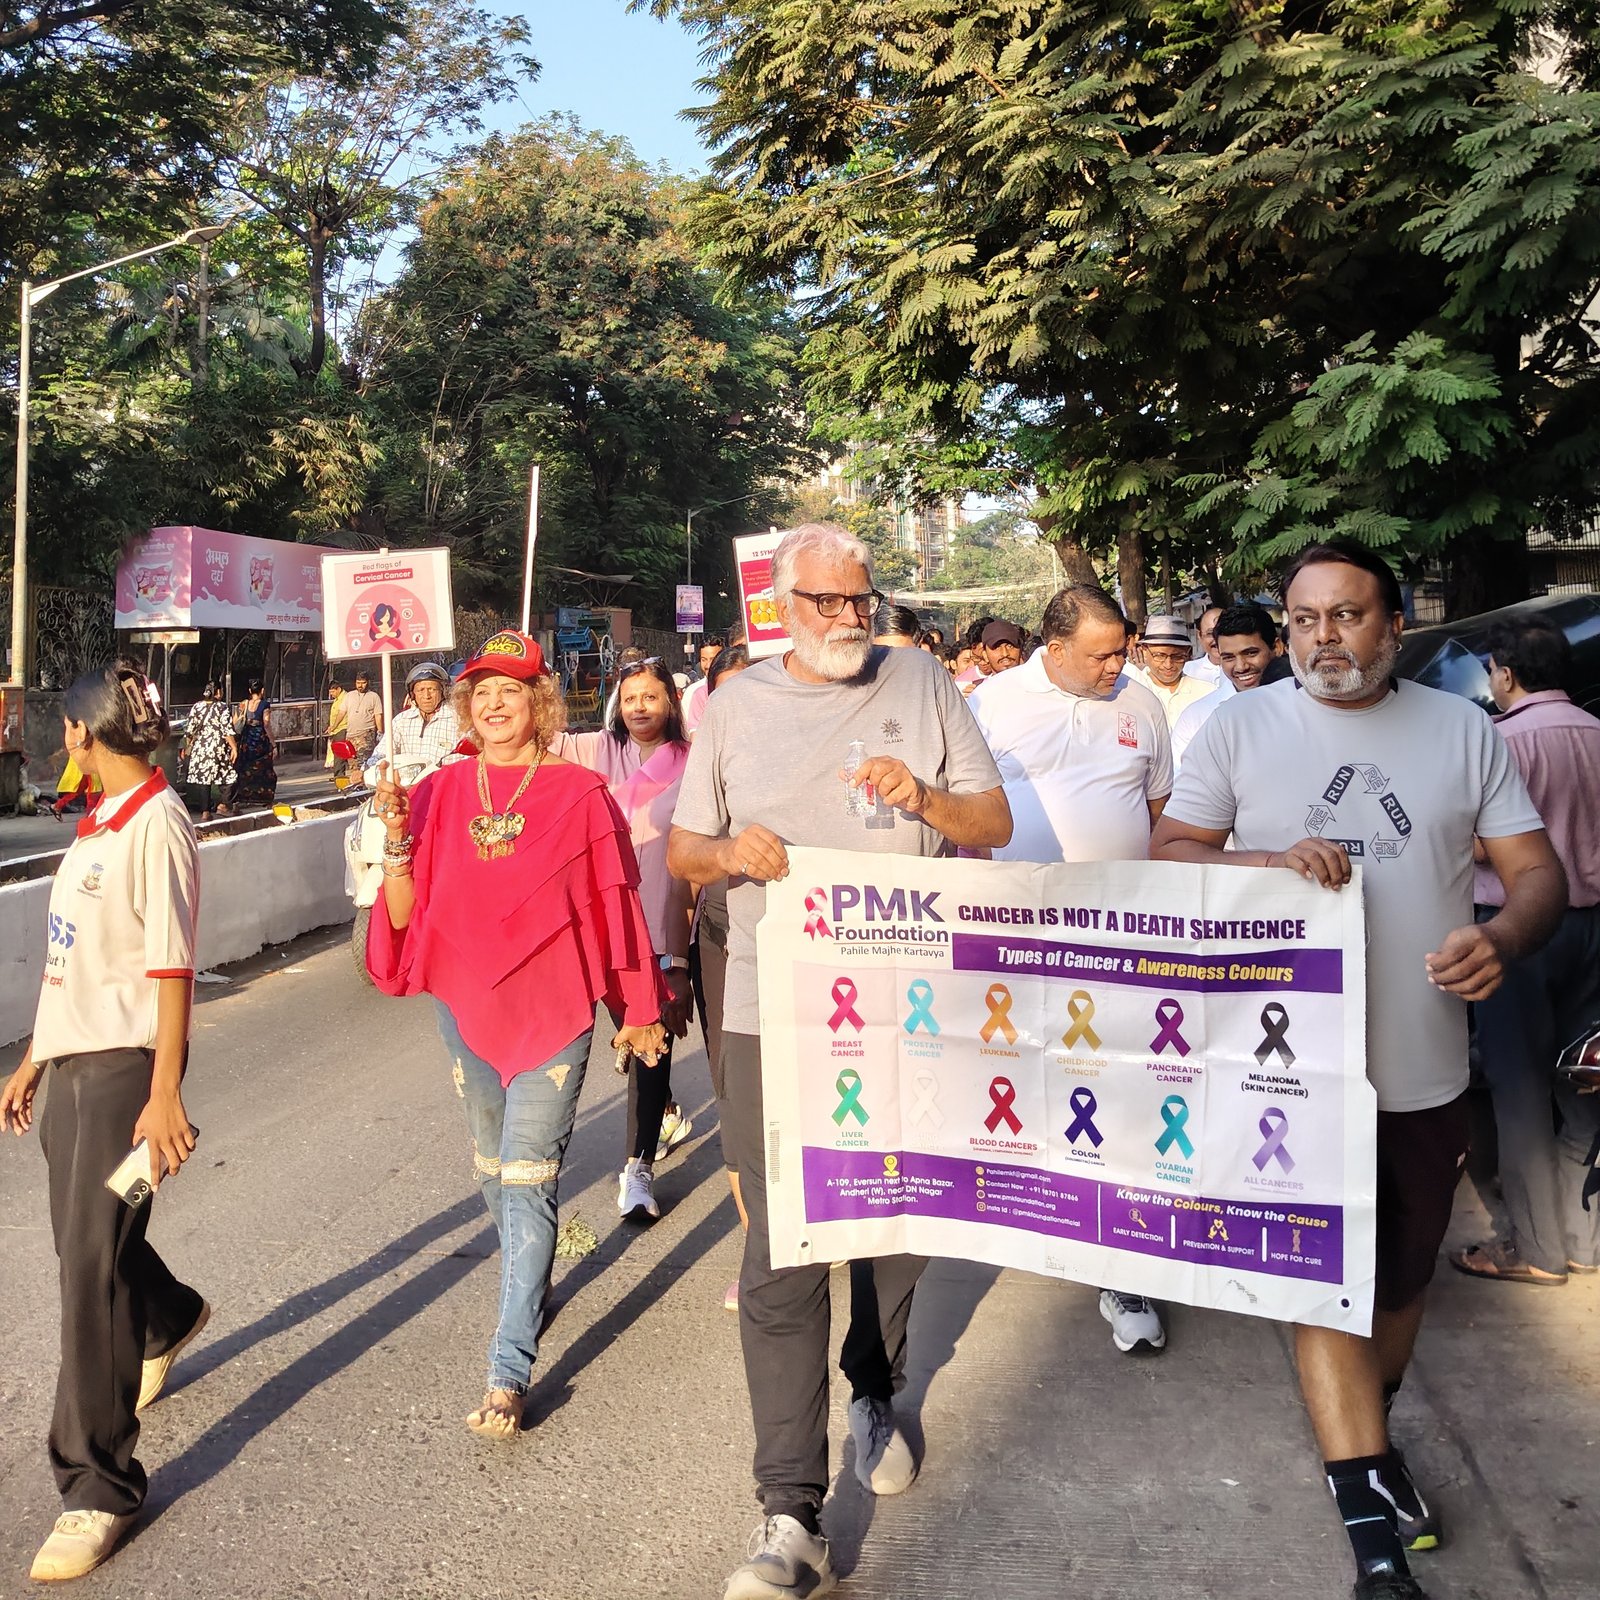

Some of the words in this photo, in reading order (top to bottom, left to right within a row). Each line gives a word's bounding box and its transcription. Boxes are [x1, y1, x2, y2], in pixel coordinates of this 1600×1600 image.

[206, 547, 231, 569] अमूल
[376, 562, 393, 570] flags
[394, 560, 402, 568] of
[355, 573, 383, 582] Cervical
[384, 570, 411, 579] Cancer
[1326, 769, 1351, 801] RUN
[1364, 766, 1385, 790] RE
[1307, 807, 1329, 831] RE
[1383, 797, 1410, 831] RUN
[1375, 841, 1397, 855] RE
[832, 884, 945, 922] PMK
[958, 904, 1034, 925] CANCER
[1039, 907, 1059, 926] IS
[1063, 907, 1102, 930] NOT
[1105, 910, 1119, 932] A
[1123, 912, 1185, 939] DEATH
[1190, 919, 1306, 940] SENTECNCE
[835, 925, 948, 943] Foundation
[840, 946, 869, 956] Pahile
[872, 945, 901, 957] Majhe
[904, 946, 945, 958] Kartavya
[997, 946, 1043, 967] Types
[1045, 950, 1063, 966] of
[1064, 950, 1121, 972] Cancer
[1122, 958, 1134, 972] &
[1136, 957, 1225, 980] Awareness
[1229, 964, 1294, 982] Colours
[832, 1040, 863, 1048] BREAST
[903, 1040, 944, 1050] PROSTATE
[830, 1049, 865, 1057] CANCER
[908, 1050, 941, 1058] CANCER
[980, 1048, 1021, 1058] LEUKEMIA
[1056, 1057, 1108, 1067] CHILDHOOD
[1146, 1063, 1203, 1074] PANCREATIC
[1064, 1067, 1100, 1077] CANCER
[1156, 1074, 1193, 1084] CANCER
[1249, 1072, 1301, 1086] MELANOMA
[1240, 1081, 1265, 1093] (SKIN
[1267, 1084, 1309, 1099] CANCER)
[835, 1139, 869, 1147] CANCER
[969, 1137, 997, 1147] BLOOD
[998, 1140, 1038, 1151] CANCERS
[1071, 1149, 1101, 1159] COLON
[1155, 1161, 1194, 1175] OVARIAN
[827, 1179, 852, 1187] A-109,
[853, 1178, 881, 1186] Eversun
[884, 1176, 901, 1185] next
[910, 1175, 931, 1184] Apna
[932, 1179, 955, 1188] Bazar,
[1156, 1172, 1191, 1185] CANCER
[1244, 1176, 1259, 1185] ALL
[1261, 1178, 1304, 1191] CANCERS
[840, 1187, 870, 1196] Andheri
[871, 1187, 886, 1196] (W),
[888, 1187, 904, 1195] near
[905, 1185, 918, 1193] DN
[919, 1186, 943, 1196] Nagar
[986, 1180, 1010, 1188] Contact
[1011, 1181, 1024, 1190] Now
[1029, 1186, 1041, 1194] +91
[868, 1197, 890, 1205] Metro
[891, 1195, 918, 1204] Station.
[987, 1193, 1056, 1210] www.pmkfoundation.org
[1116, 1188, 1151, 1204] Know
[1152, 1194, 1173, 1207] the
[1173, 1197, 1224, 1215] Colours,
[1226, 1205, 1263, 1219] Know
[1264, 1210, 1286, 1222] the
[1287, 1213, 1329, 1228] Cause
[1113, 1226, 1130, 1236] EARLY
[1131, 1229, 1164, 1242] DETECTION
[1183, 1239, 1220, 1251] PREVENTION
[1227, 1246, 1255, 1256] SUPPORT
[1271, 1252, 1289, 1261] HOPE
[1289, 1255, 1304, 1263] FOR
[1304, 1257, 1322, 1266] CURE
